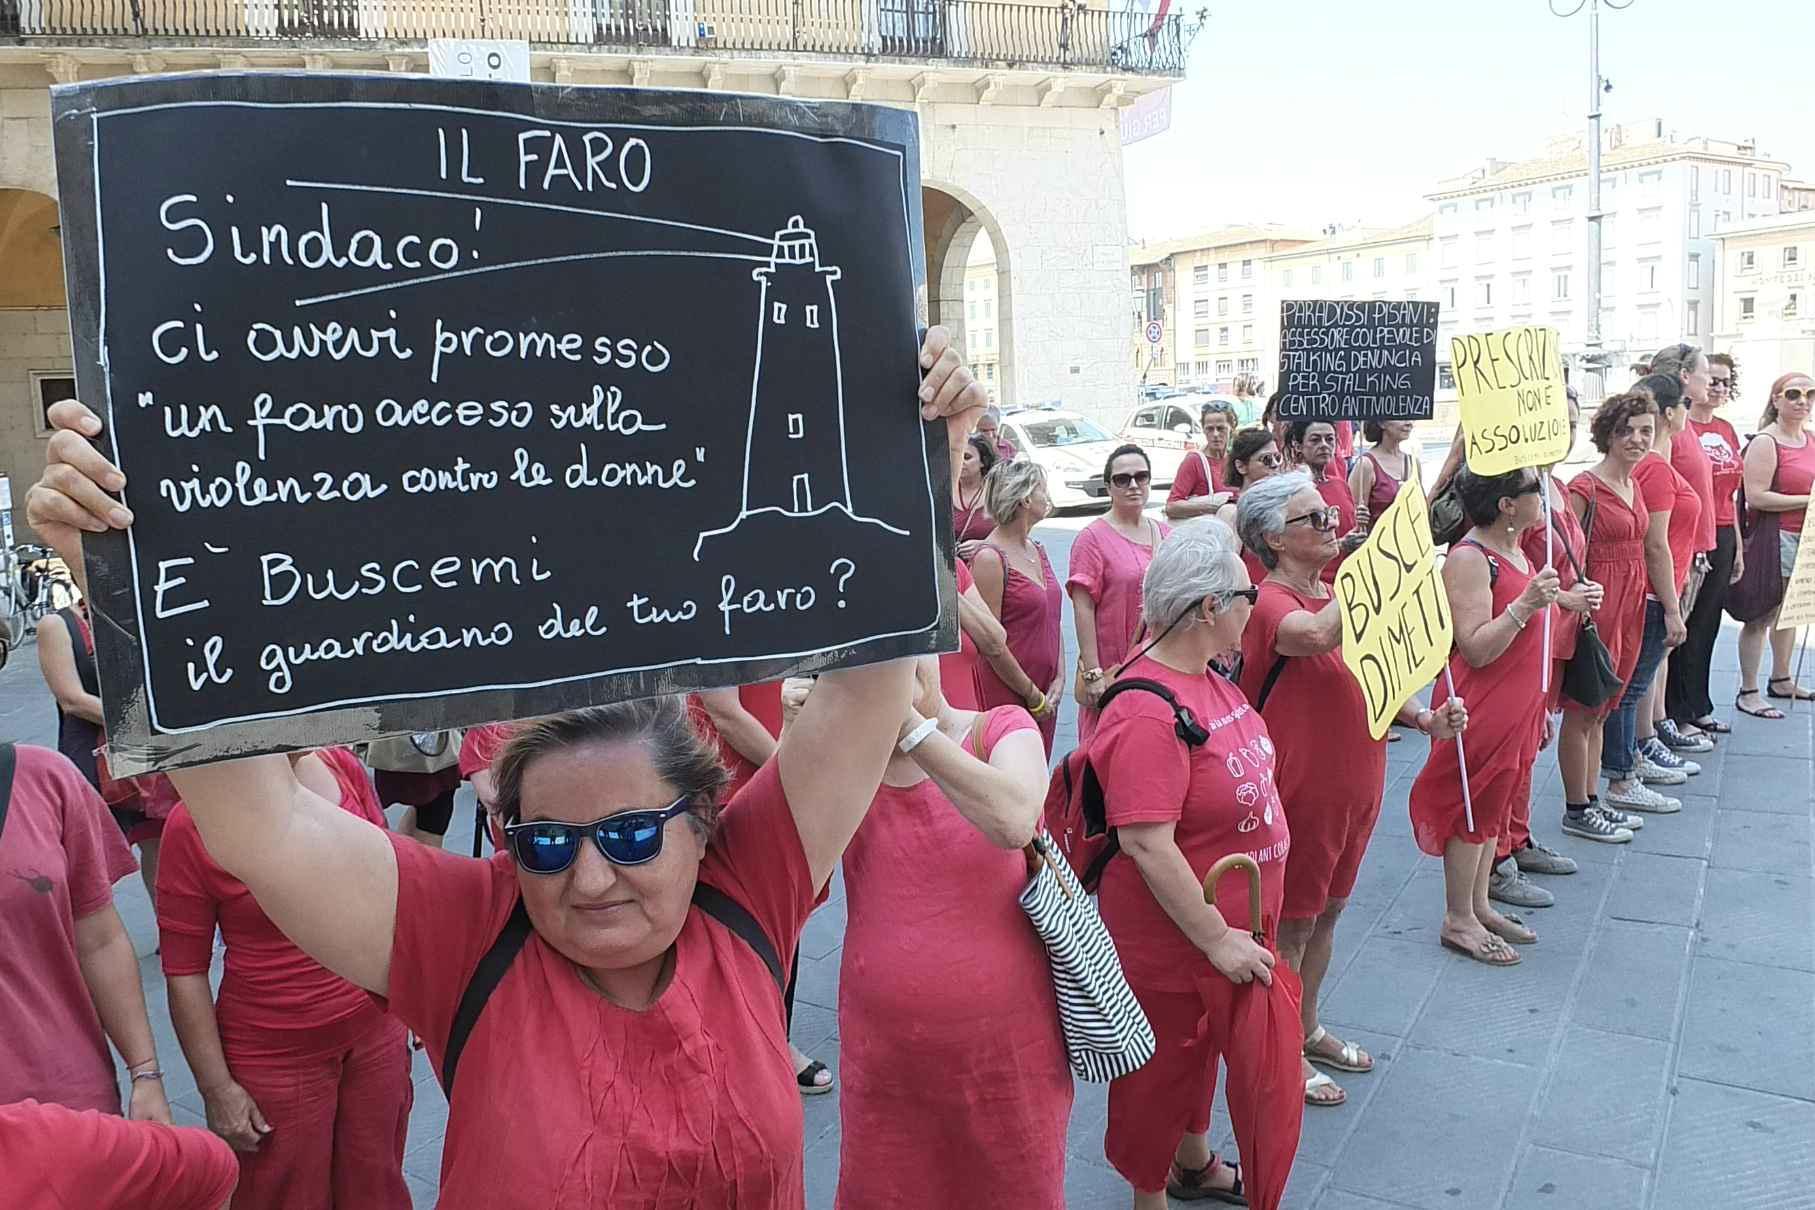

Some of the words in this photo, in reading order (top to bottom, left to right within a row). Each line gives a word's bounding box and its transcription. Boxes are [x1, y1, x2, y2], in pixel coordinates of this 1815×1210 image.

[439, 128, 483, 183] IL
[518, 130, 652, 193] FARO
[159, 193, 482, 269] Sindaco!
[1279, 328, 1350, 350] ASSESSORE
[1351, 327, 1421, 349] COLPEVOLE
[1423, 328, 1438, 345] DI
[1280, 300, 1369, 326] PARADOSSI
[248, 310, 412, 360] avevi
[432, 319, 670, 382] promesso
[1279, 350, 1346, 373] STALKING
[1351, 349, 1422, 373] DENUNCIA
[1279, 393, 1340, 417] CENTRO
[1288, 372, 1321, 393] PER
[1322, 372, 1412, 394] STALKING
[1516, 388, 1543, 417] NON
[139, 392, 232, 437] "un
[248, 394, 363, 460] faro
[376, 400, 532, 427] acceso
[550, 385, 666, 434] sulla
[161, 455, 387, 511] violenza
[403, 457, 497, 492] contro
[510, 448, 552, 487] le
[566, 444, 704, 488] donne"
[261, 536, 555, 607] Buscemi
[186, 636, 232, 690] il
[261, 615, 516, 696] guardiano
[539, 603, 606, 638] del
[627, 594, 696, 623] tuo
